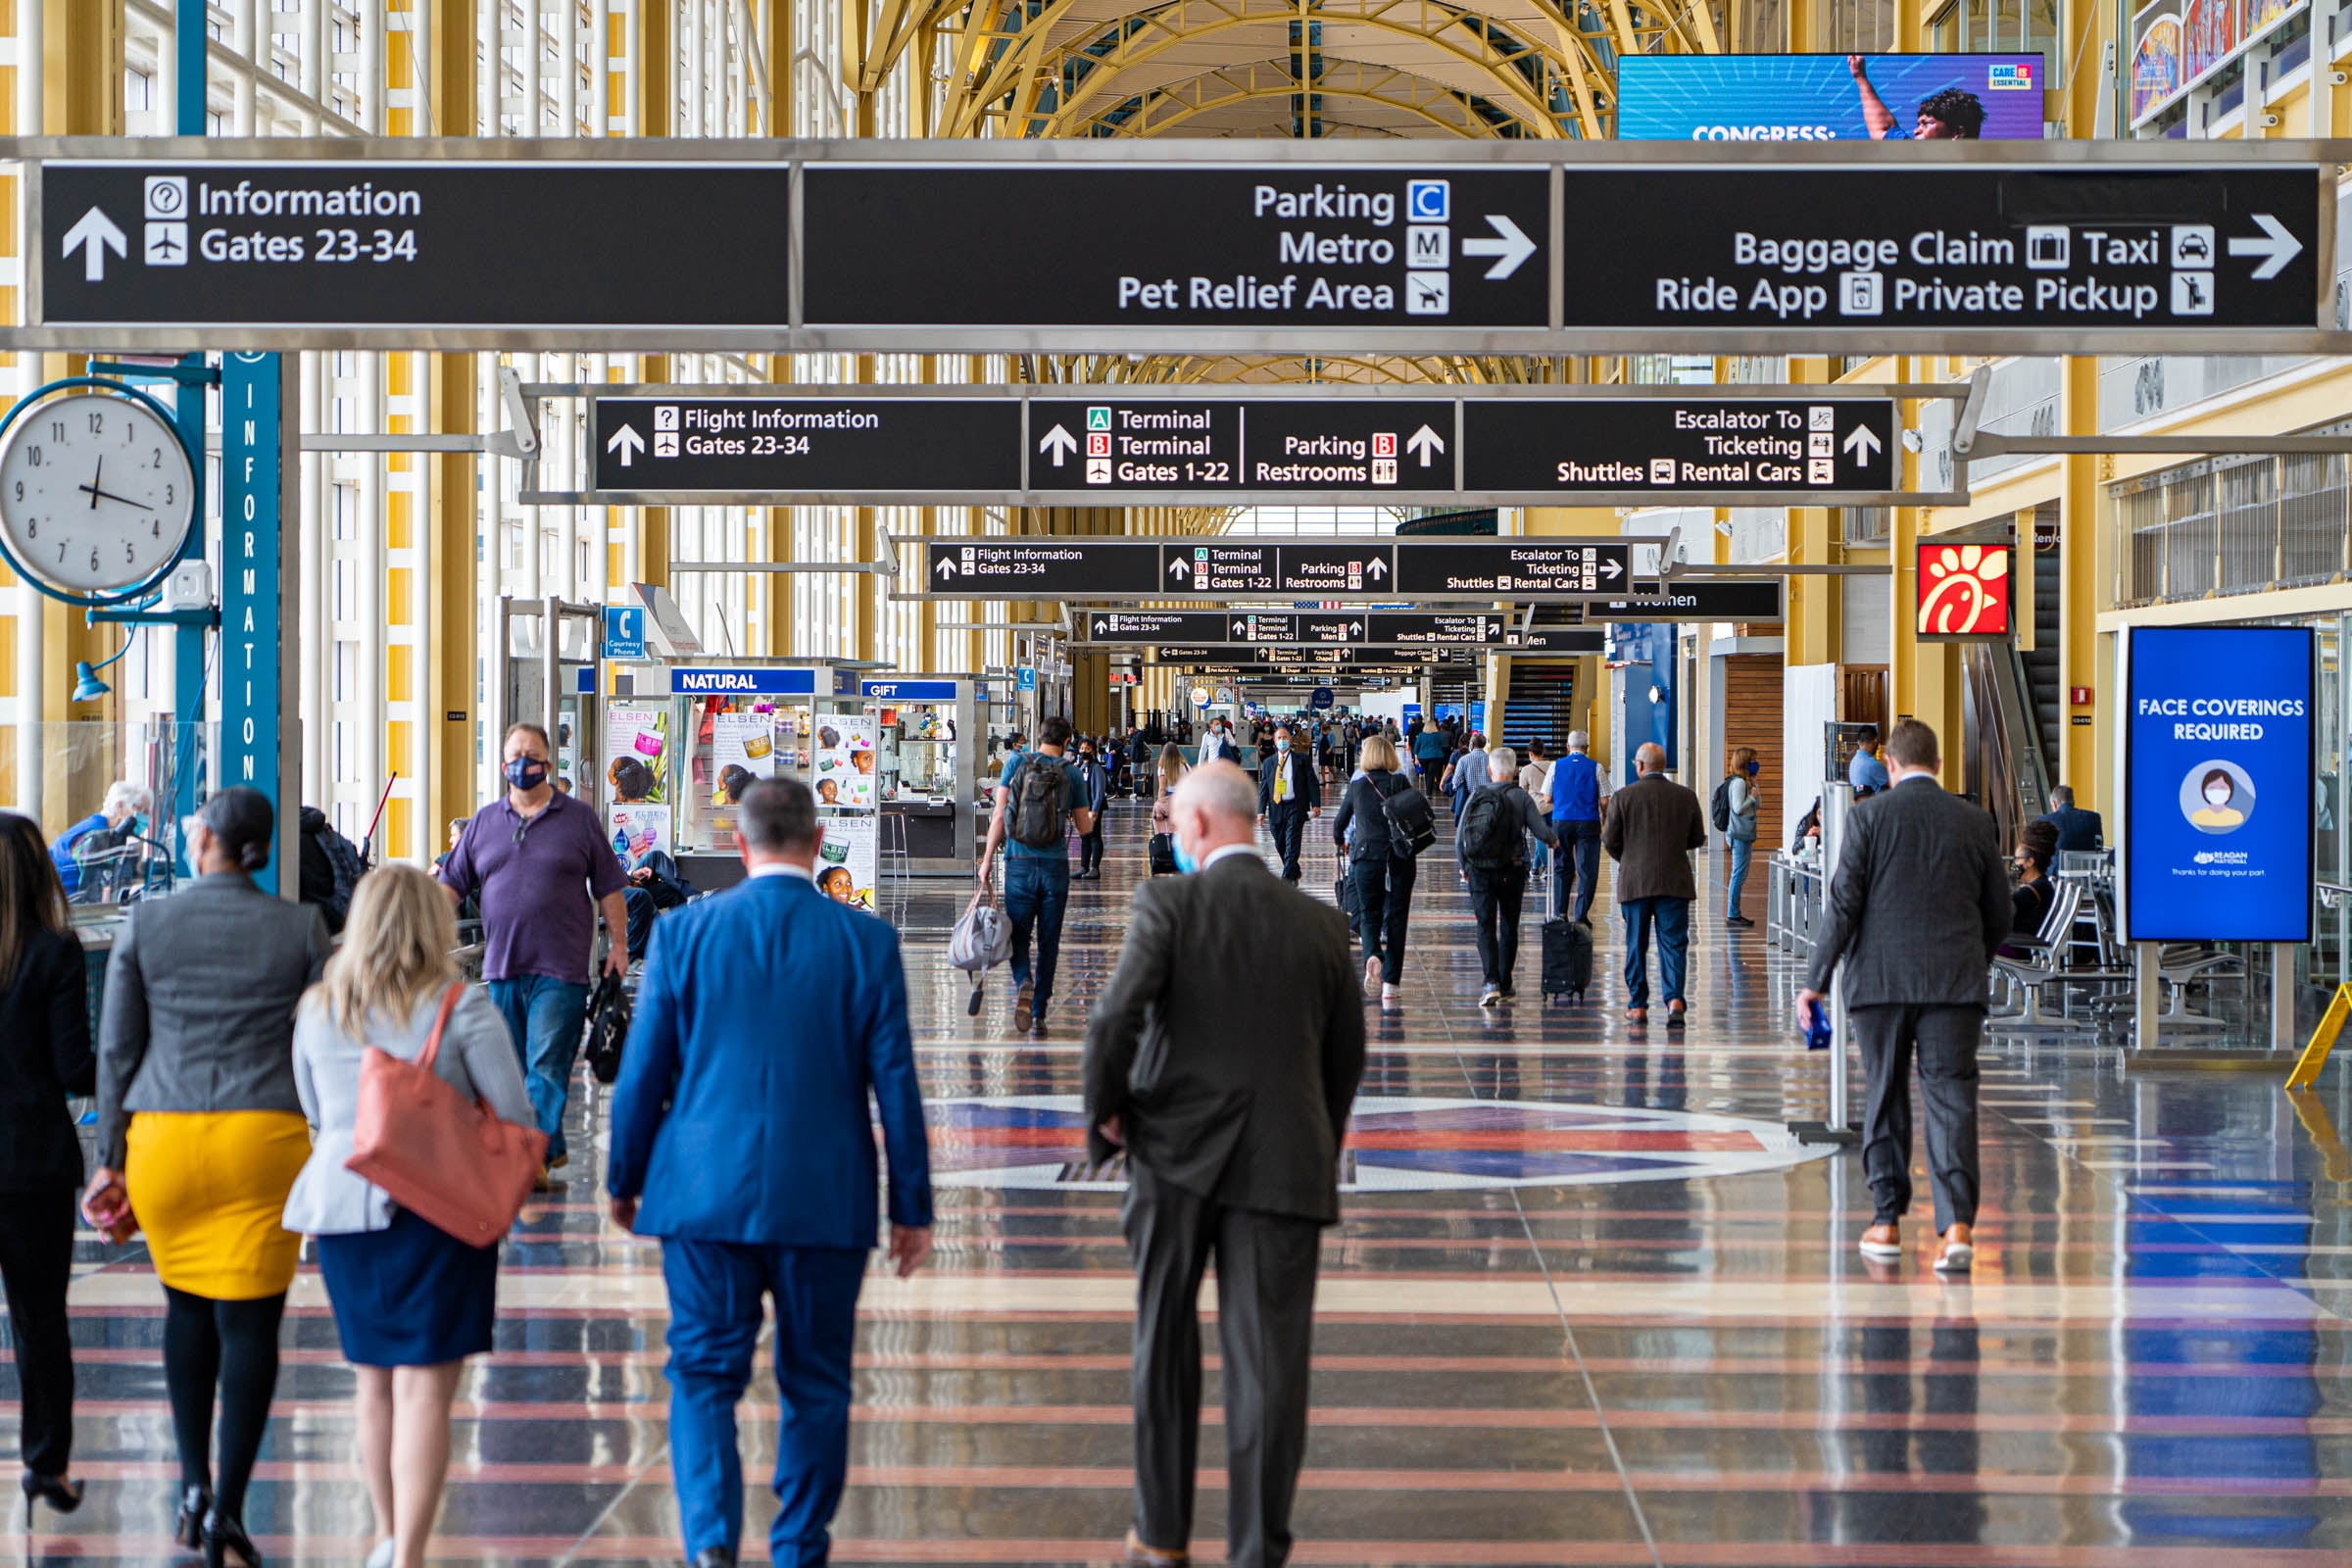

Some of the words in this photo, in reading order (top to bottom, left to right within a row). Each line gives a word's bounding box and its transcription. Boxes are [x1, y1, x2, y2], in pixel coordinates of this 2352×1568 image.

[1993, 68, 2015, 77] CARE
[2019, 68, 2028, 77] IS
[1993, 78, 2027, 87] ESSENTIAL
[200, 180, 420, 216] Information
[1255, 184, 1394, 225] Parking
[201, 228, 304, 261] Gates
[316, 229, 416, 261] 23-34
[1281, 232, 1394, 264] Metro
[1736, 232, 1898, 275] Baggage
[1911, 230, 2014, 264] Claim
[2083, 231, 2158, 264] Taxi
[1119, 277, 1178, 309] Pet
[1191, 275, 1297, 309] Relief
[1305, 277, 1394, 309] Area
[1657, 277, 1738, 311] Ride
[1748, 278, 1827, 318] App
[1895, 277, 2023, 311] Private
[2036, 276, 2157, 318] Pickup
[89, 414, 102, 434] 12
[686, 409, 746, 431] Flight
[753, 409, 878, 428] Information
[1118, 410, 1210, 428] Terminal
[1676, 410, 1770, 428] Escalator
[1776, 411, 1801, 428] To
[52, 422, 65, 442] 11
[126, 423, 133, 442] 1
[686, 436, 745, 455] Gates
[752, 436, 809, 455] 23-34
[1118, 436, 1209, 455] Terminal
[1286, 436, 1365, 458] Parking
[1704, 436, 1801, 458] Ticketing
[27, 446, 41, 466] 10
[153, 448, 162, 468] 2
[1118, 463, 1178, 481] Gates
[1186, 463, 1229, 481] 1-22
[1257, 463, 1366, 481] Restrooms
[1558, 462, 1643, 481] Shuttles
[1683, 462, 1749, 481] Rental
[1757, 463, 1801, 481] Cars
[16, 481, 24, 502] 9
[166, 485, 173, 505] 3
[28, 518, 36, 538] 8
[151, 519, 160, 539] 4
[59, 543, 66, 564] 7
[90, 551, 99, 571] 6
[126, 543, 134, 564] 5
[977, 550, 1011, 562] Flight
[1013, 549, 1082, 562] Information
[1212, 549, 1261, 560] Terminal
[1511, 550, 1561, 560] Escalator
[1565, 550, 1579, 560] To
[979, 564, 1009, 573] Gates
[1013, 564, 1045, 573] 23-34
[1211, 564, 1261, 573] Terminal
[1301, 564, 1345, 577] Parking
[1527, 564, 1579, 577] Ticketing
[243, 383, 255, 780] INFORMATION
[1211, 577, 1243, 588] Gates
[1248, 577, 1271, 588] 1-22
[1287, 578, 1346, 588] Restrooms
[1447, 577, 1494, 588] Shuttles
[1515, 577, 1550, 588] Rental
[1554, 578, 1579, 588] Cars
[1119, 615, 1140, 624] Flight
[1310, 624, 1338, 633] Parking
[1445, 625, 1476, 634] Ticketing
[609, 640, 641, 649] Courtesy
[682, 674, 758, 689] NATURAL
[870, 685, 898, 696] GIFT
[610, 711, 653, 721] ELSEN
[2139, 699, 2187, 715] FACE
[2192, 699, 2304, 715] COVERINGS
[717, 714, 771, 723] ELSEN
[819, 717, 871, 726] ELSEN
[2175, 723, 2263, 741] REQUIRED
[817, 819, 872, 828] ELSEN
[2209, 868, 2230, 878] doing
